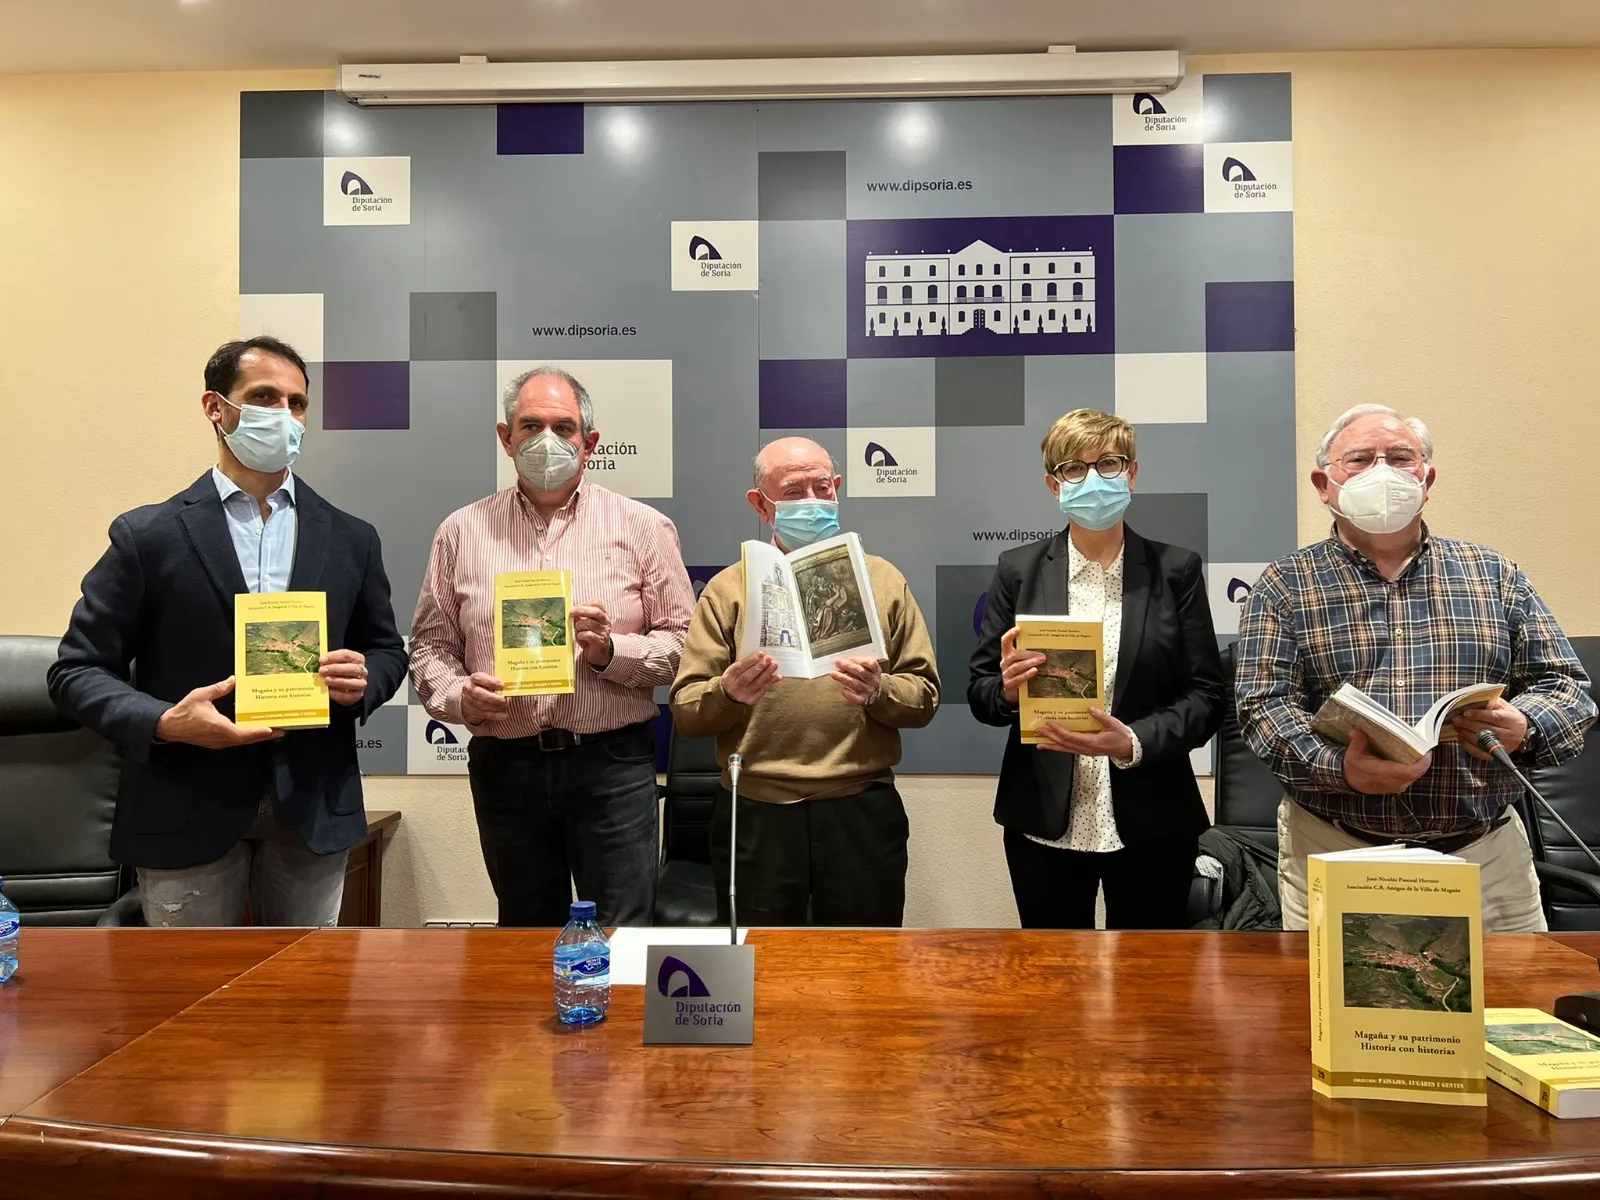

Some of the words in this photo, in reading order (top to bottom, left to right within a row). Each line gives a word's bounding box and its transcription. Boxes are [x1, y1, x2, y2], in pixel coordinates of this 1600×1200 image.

[1144, 115, 1187, 124] Diputación
[1144, 123, 1155, 131] de
[1155, 123, 1176, 131] Soria
[866, 178, 973, 193] www.dipsoria.es
[1234, 182, 1277, 192] Diputación
[1234, 190, 1244, 198] de
[1245, 190, 1266, 198] Soria
[352, 196, 393, 206] Diputación
[351, 204, 362, 212] de
[362, 204, 382, 212] Soria
[700, 261, 742, 270] Diputación
[700, 269, 710, 277] de
[711, 269, 731, 277] Soria
[532, 324, 637, 338] www.dipsoria.es
[593, 441, 638, 455] ación
[876, 467, 918, 477] Diputación
[876, 475, 886, 483] de
[886, 475, 907, 483] Soria
[676, 1000, 741, 1017] Diputación
[675, 1014, 689, 1026] de
[692, 1014, 724, 1026] Soria
[1354, 1030, 1389, 1041] Magaña
[1411, 1035, 1461, 1044] patrimonio
[1360, 1042, 1396, 1052] Historia
[1417, 1046, 1456, 1056] historias
